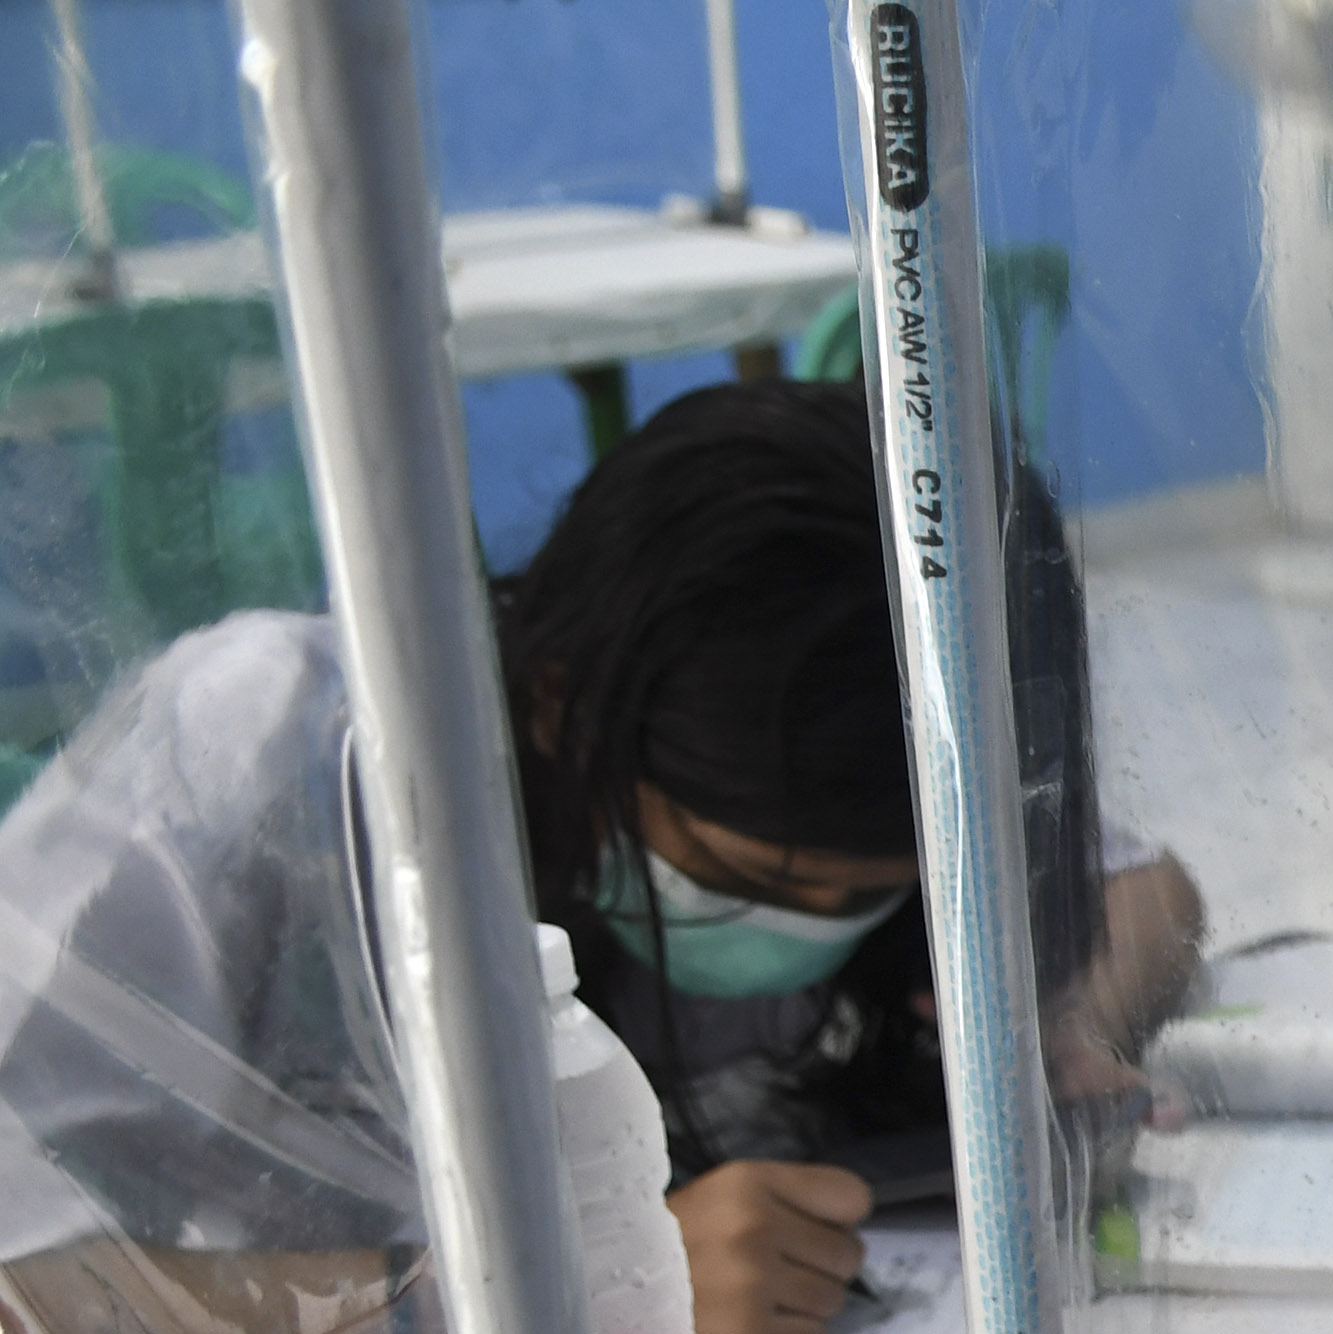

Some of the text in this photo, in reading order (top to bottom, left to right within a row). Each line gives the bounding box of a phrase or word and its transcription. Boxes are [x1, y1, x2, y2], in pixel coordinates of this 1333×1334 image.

[877, 24, 917, 190] RUCIKA
[891, 228, 922, 302] PVC
[897, 306, 928, 365] AW
[912, 469, 948, 580] C714
